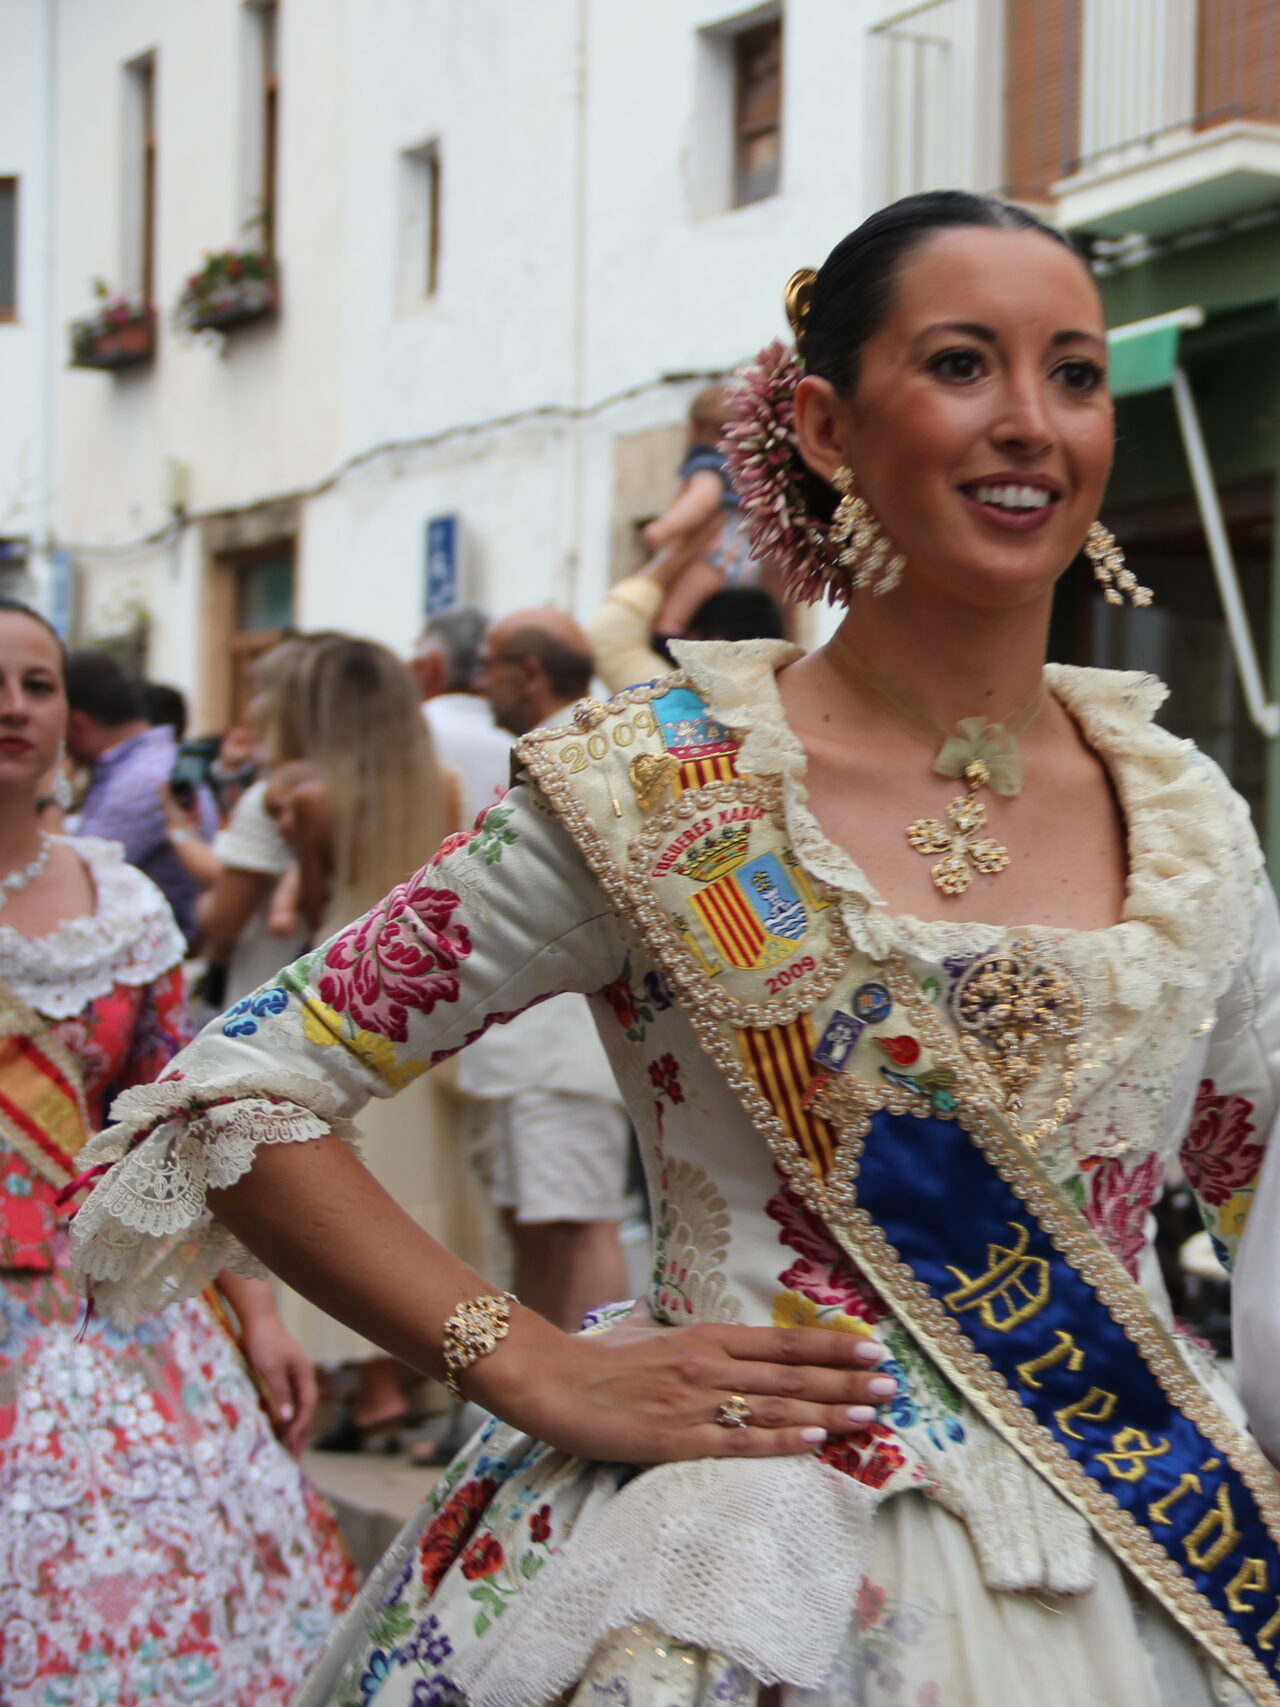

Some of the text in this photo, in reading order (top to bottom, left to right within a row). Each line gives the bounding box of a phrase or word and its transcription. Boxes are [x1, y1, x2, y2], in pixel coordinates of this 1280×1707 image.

[559, 711, 656, 774] 2009
[651, 817, 713, 877] FOGUERES
[764, 956, 816, 995] 2009
